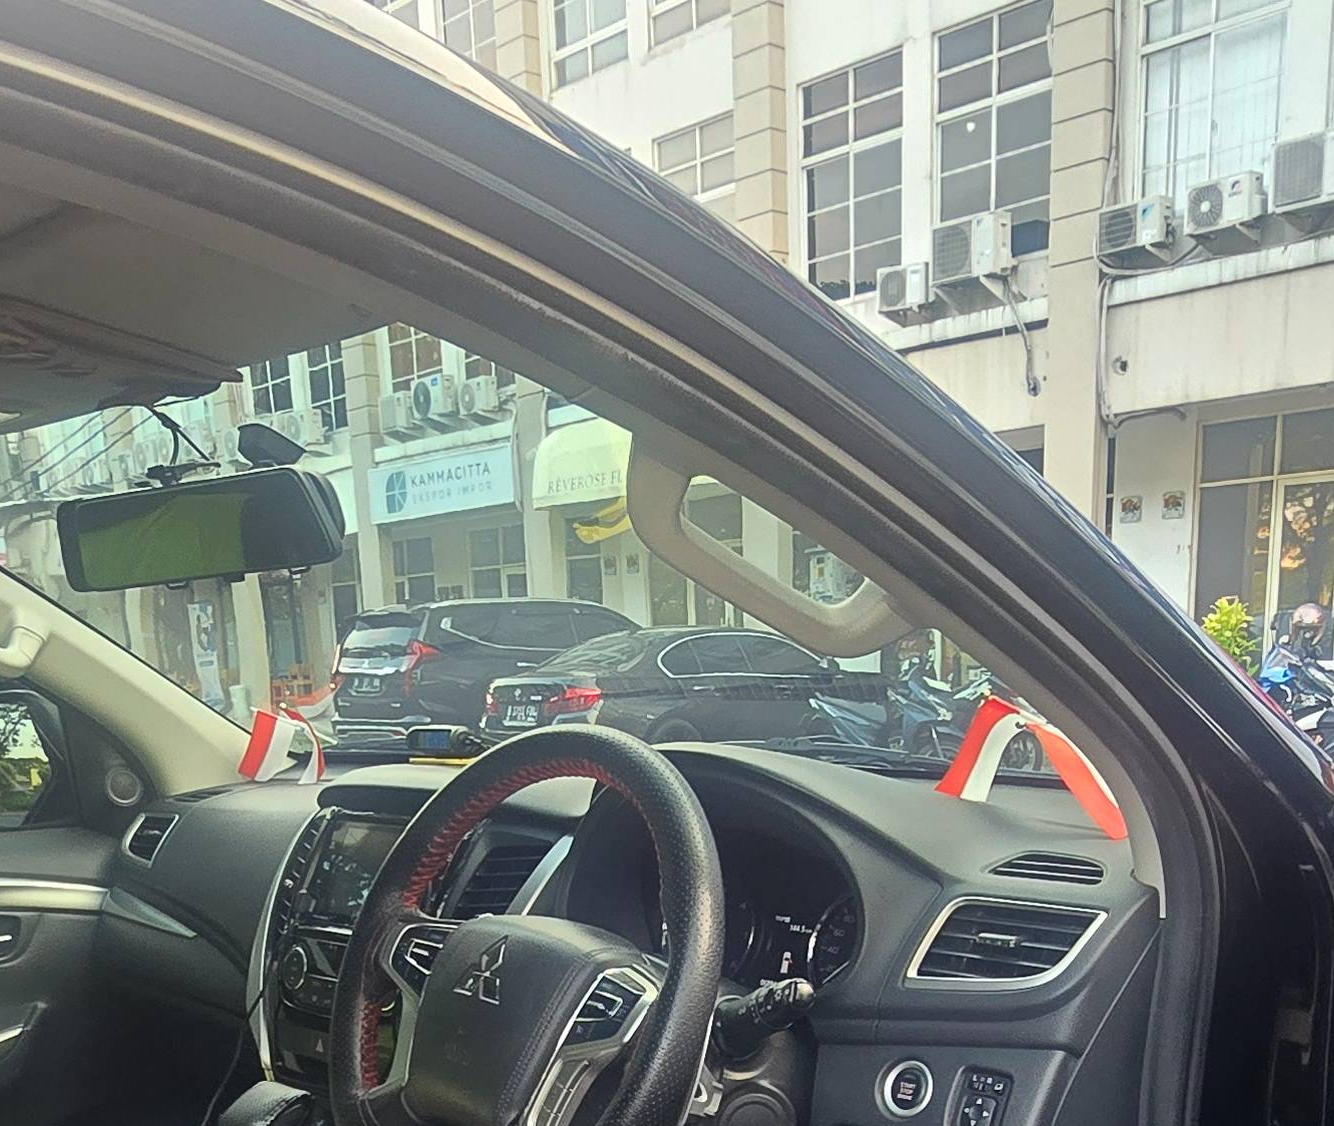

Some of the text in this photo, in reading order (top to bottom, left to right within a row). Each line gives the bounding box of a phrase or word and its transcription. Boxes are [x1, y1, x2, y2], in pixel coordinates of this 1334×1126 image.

[410, 461, 491, 488] KAMMACITTA
[412, 480, 493, 504] EKSPOR IMPOR
